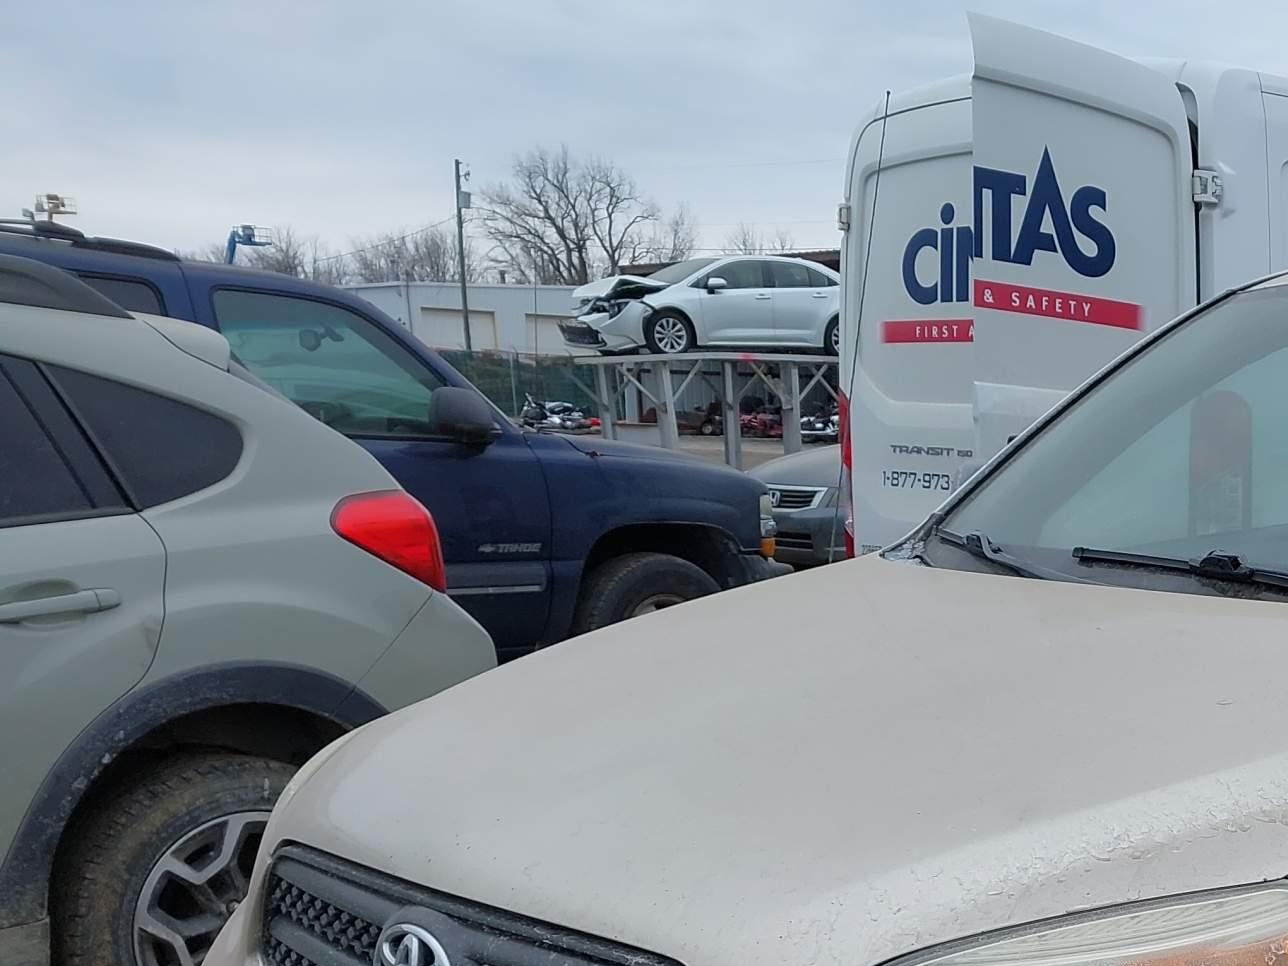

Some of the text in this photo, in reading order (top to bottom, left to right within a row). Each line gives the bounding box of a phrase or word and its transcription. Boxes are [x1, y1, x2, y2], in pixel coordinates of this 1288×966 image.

[983, 288, 1092, 317] & SAFETY
[915, 325, 958, 338] FIRST
[890, 444, 954, 456] TRANSIT
[498, 543, 542, 552] TAHOE
